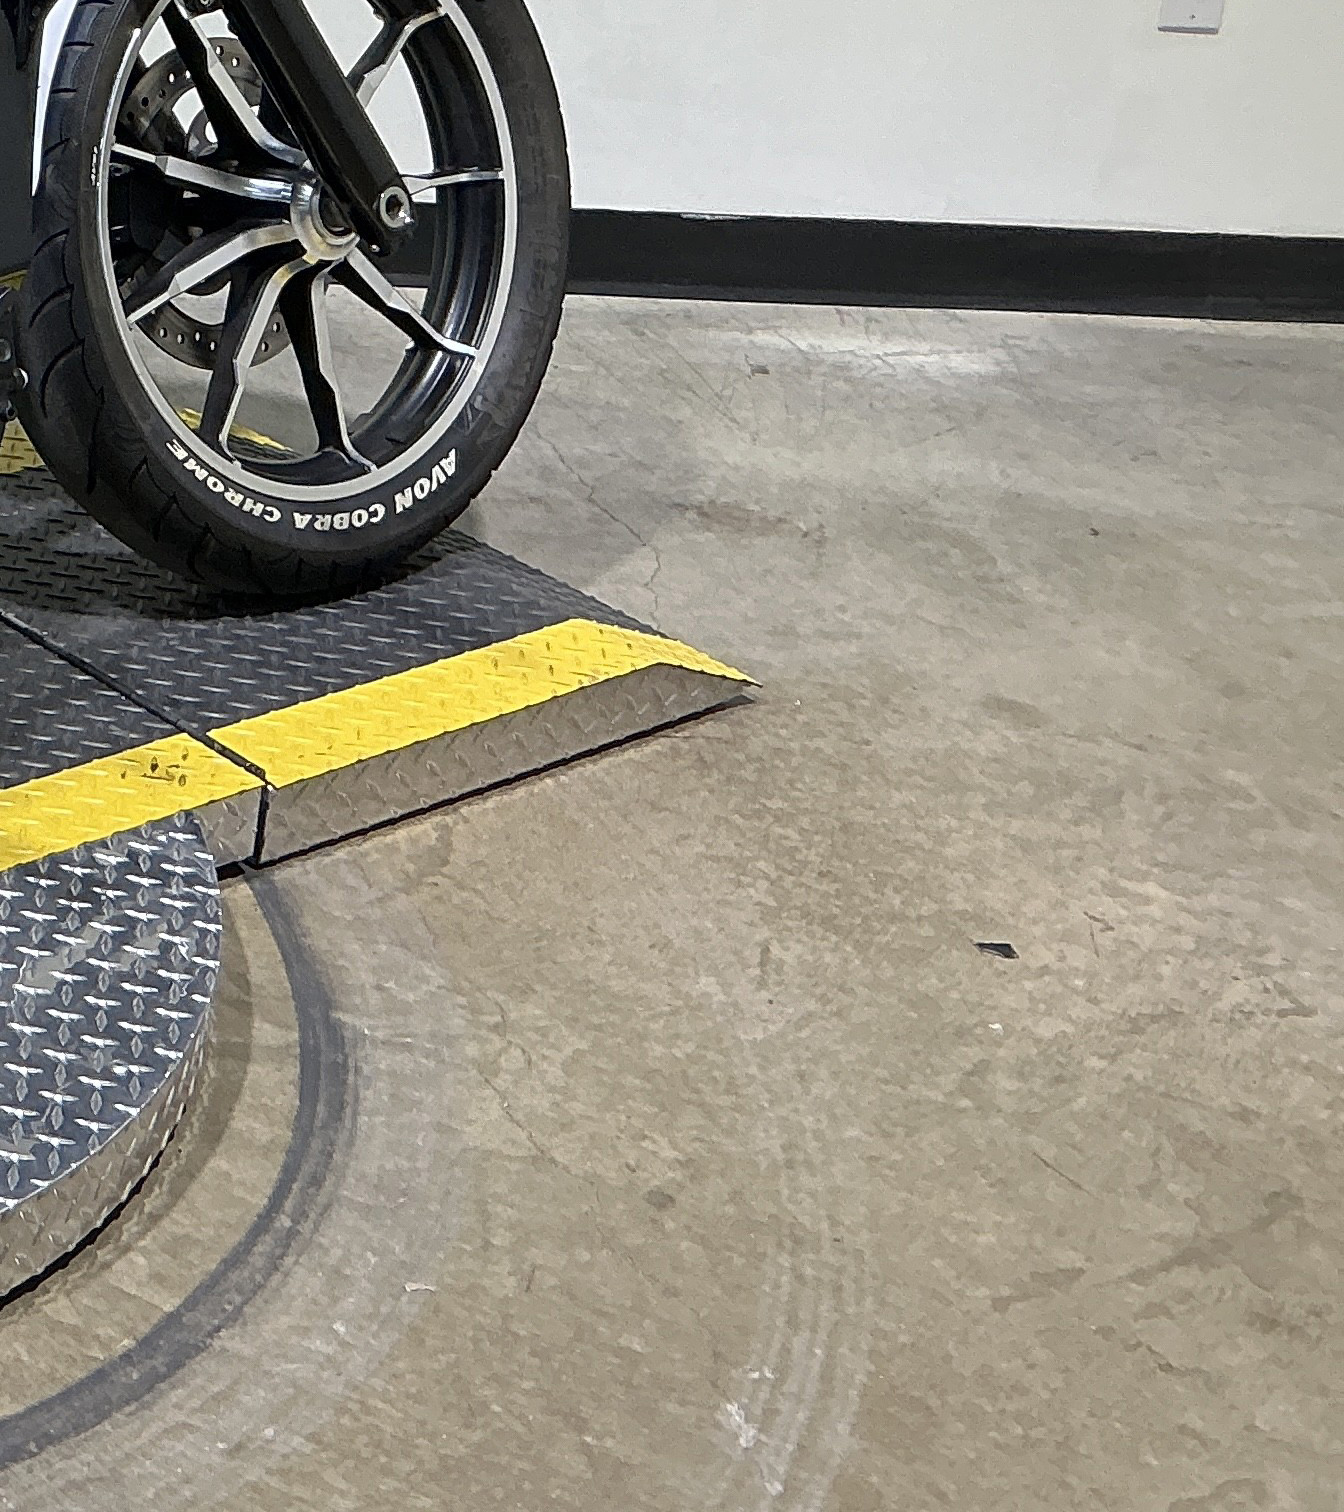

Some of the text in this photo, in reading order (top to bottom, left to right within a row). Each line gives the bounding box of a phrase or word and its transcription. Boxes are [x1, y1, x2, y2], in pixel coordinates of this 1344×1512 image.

[164, 438, 457, 531] AVON COBRA CHROME
